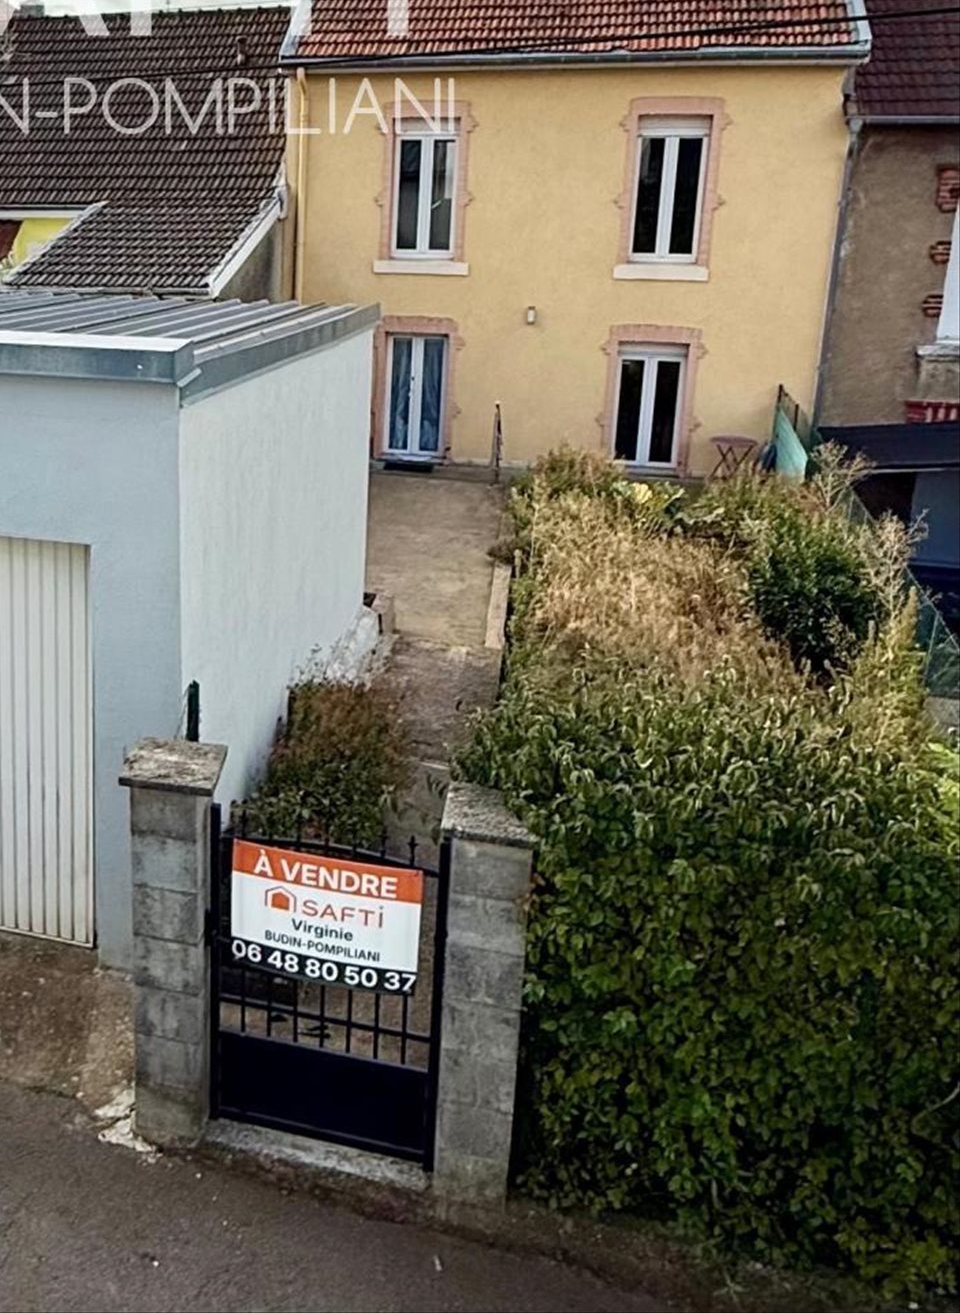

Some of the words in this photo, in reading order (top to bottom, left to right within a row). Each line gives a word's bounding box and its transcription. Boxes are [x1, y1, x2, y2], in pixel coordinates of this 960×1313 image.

[253, 849, 274, 877] À
[280, 858, 398, 899] VENDRE
[264, 929, 381, 963] BUDIN-POMPILIANI
[291, 918, 354, 942] Virginie
[231, 939, 262, 963] 06
[267, 952, 300, 973] 48
[305, 959, 339, 981] 80
[344, 966, 378, 988] 50
[384, 972, 417, 992] 37
